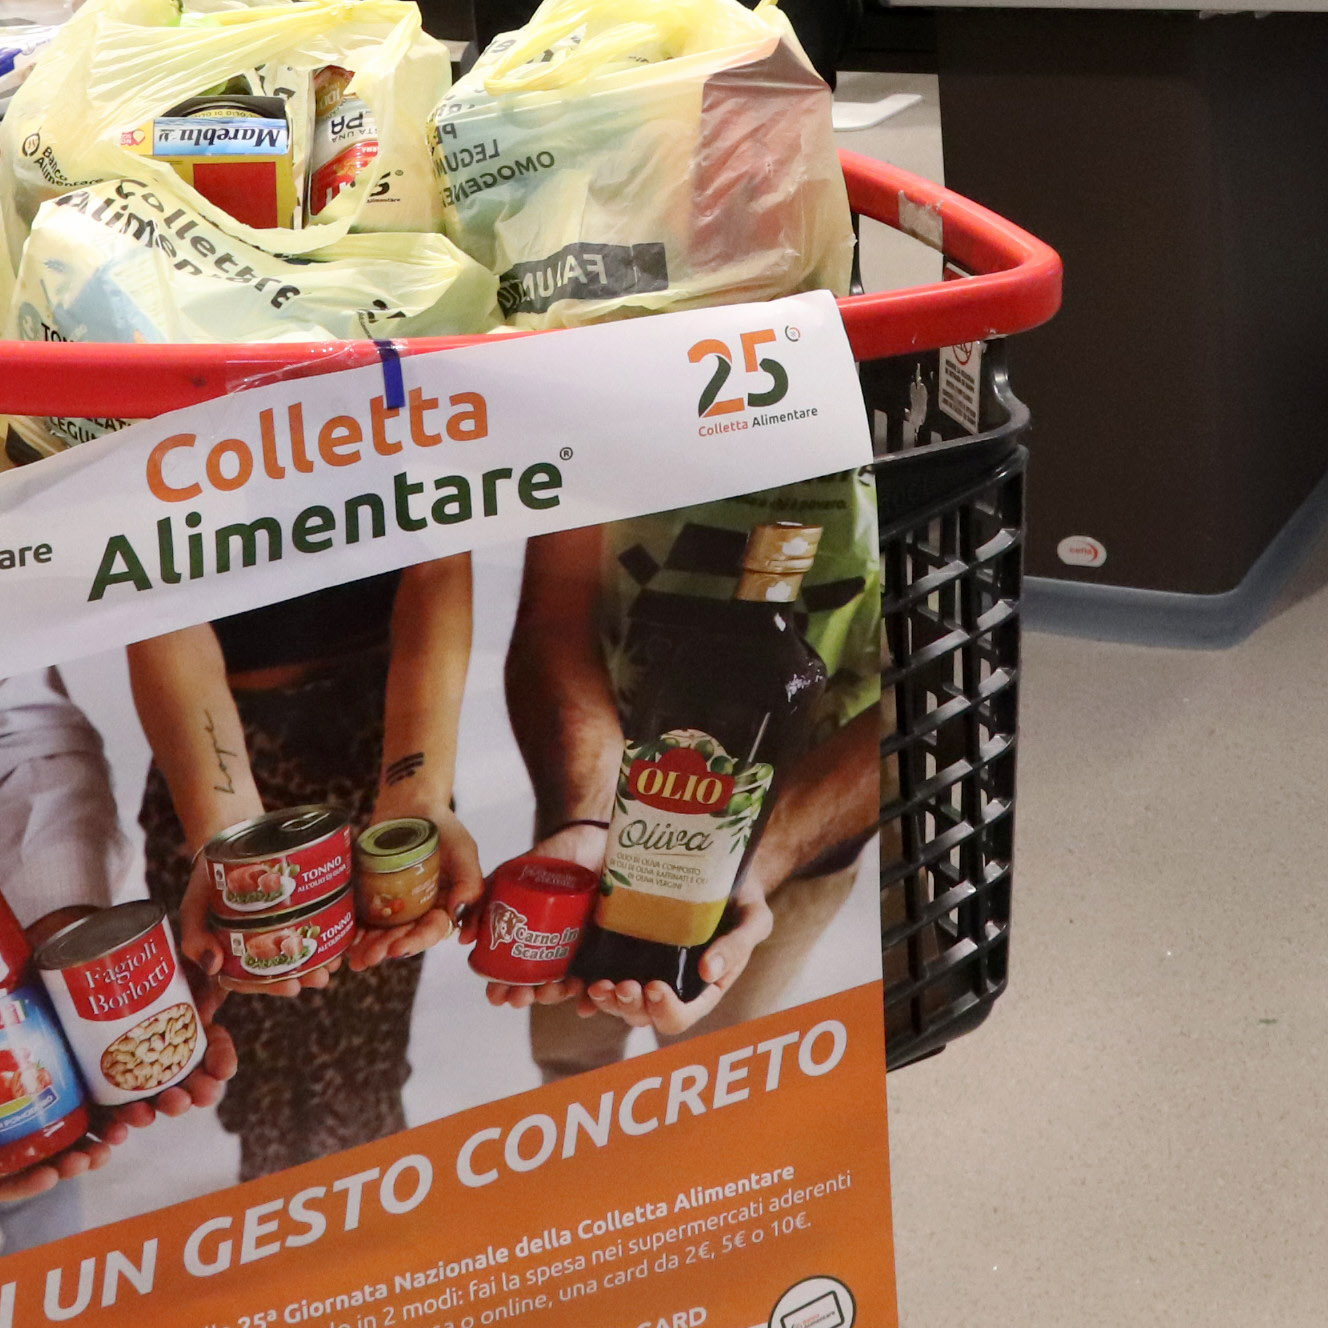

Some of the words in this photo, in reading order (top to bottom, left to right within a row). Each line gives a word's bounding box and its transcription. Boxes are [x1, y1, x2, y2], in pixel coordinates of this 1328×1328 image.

[179, 127, 281, 148] Mareblu
[41, 146, 69, 182] Banco
[686, 328, 790, 419] 25
[698, 420, 749, 438] Colletta
[751, 405, 819, 429] Alimentare
[145, 385, 490, 504] Colletta
[636, 767, 724, 806] OLIO
[618, 818, 715, 852] Oliva
[301, 855, 342, 883] TONNO
[320, 911, 352, 942] TONNO
[514, 925, 560, 946] Carne
[561, 925, 580, 943] in
[84, 937, 158, 990] Fagioli
[511, 942, 570, 962] Scatola
[87, 955, 171, 1016] Borlotti
[43, 1237, 160, 1323] UN
[183, 1153, 435, 1279] GESTO
[454, 1019, 849, 1189] CONCRETO
[283, 1282, 390, 1326] Giornata
[394, 1244, 510, 1296] Nazionale
[515, 1226, 573, 1259] della
[576, 1199, 669, 1240] Colletta
[673, 1164, 796, 1213] Alimentare
[383, 1306, 397, 1325] 2
[401, 1288, 465, 1323] modi:
[468, 1275, 498, 1302] fai
[501, 1270, 521, 1291] la
[525, 1253, 587, 1288] spesa
[591, 1238, 624, 1267] nei
[628, 1196, 765, 1256] supermercati
[768, 1169, 853, 1213] aderenti
[480, 1287, 554, 1325] online,
[559, 1278, 599, 1302] una
[603, 1258, 650, 1288] card
[653, 1252, 680, 1275] da
[684, 1240, 718, 1266] 2€,
[722, 1230, 748, 1253] 5€
[751, 1228, 765, 1244] o
[771, 1210, 813, 1237] 10€.
